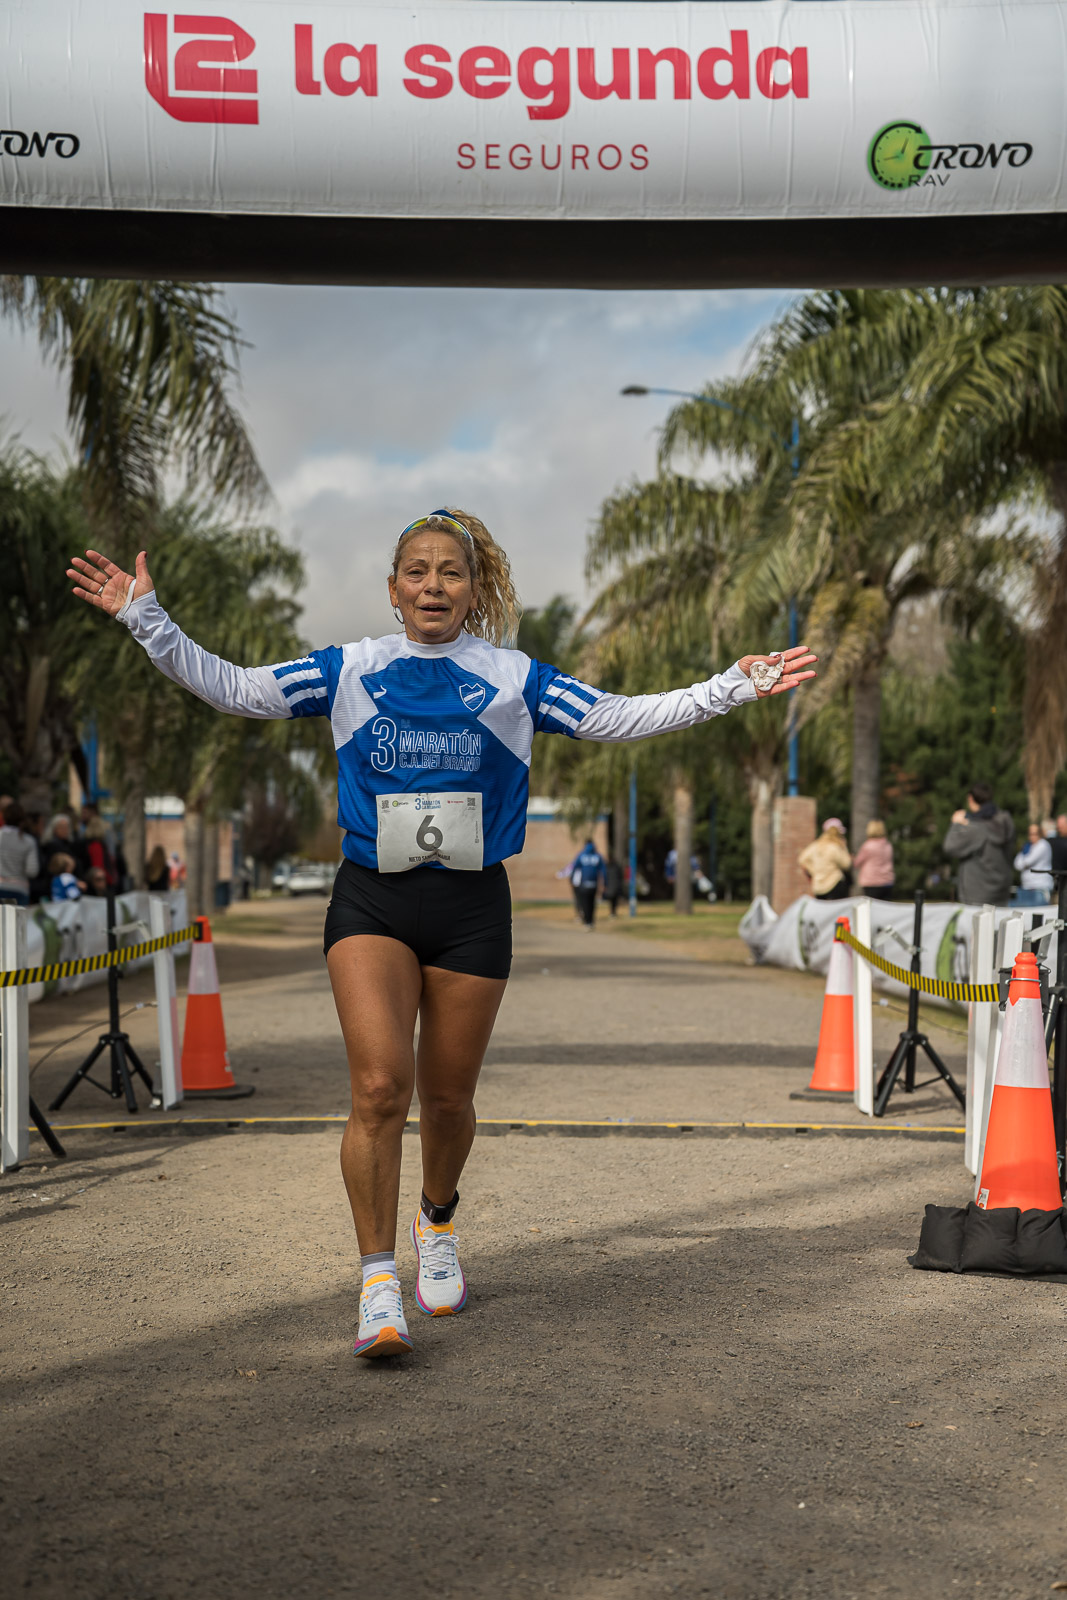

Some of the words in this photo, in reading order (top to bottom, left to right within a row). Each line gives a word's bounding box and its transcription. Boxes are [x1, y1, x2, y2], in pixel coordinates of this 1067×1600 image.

[295, 24, 377, 96] la
[404, 30, 808, 120] segunda
[0, 130, 80, 158] ONO
[458, 143, 648, 170] SEGUROS
[913, 143, 1033, 170] CRONO
[908, 174, 950, 187] RAV
[371, 717, 396, 773] 3
[399, 729, 481, 756] MARATÓN
[416, 815, 443, 852] 6
